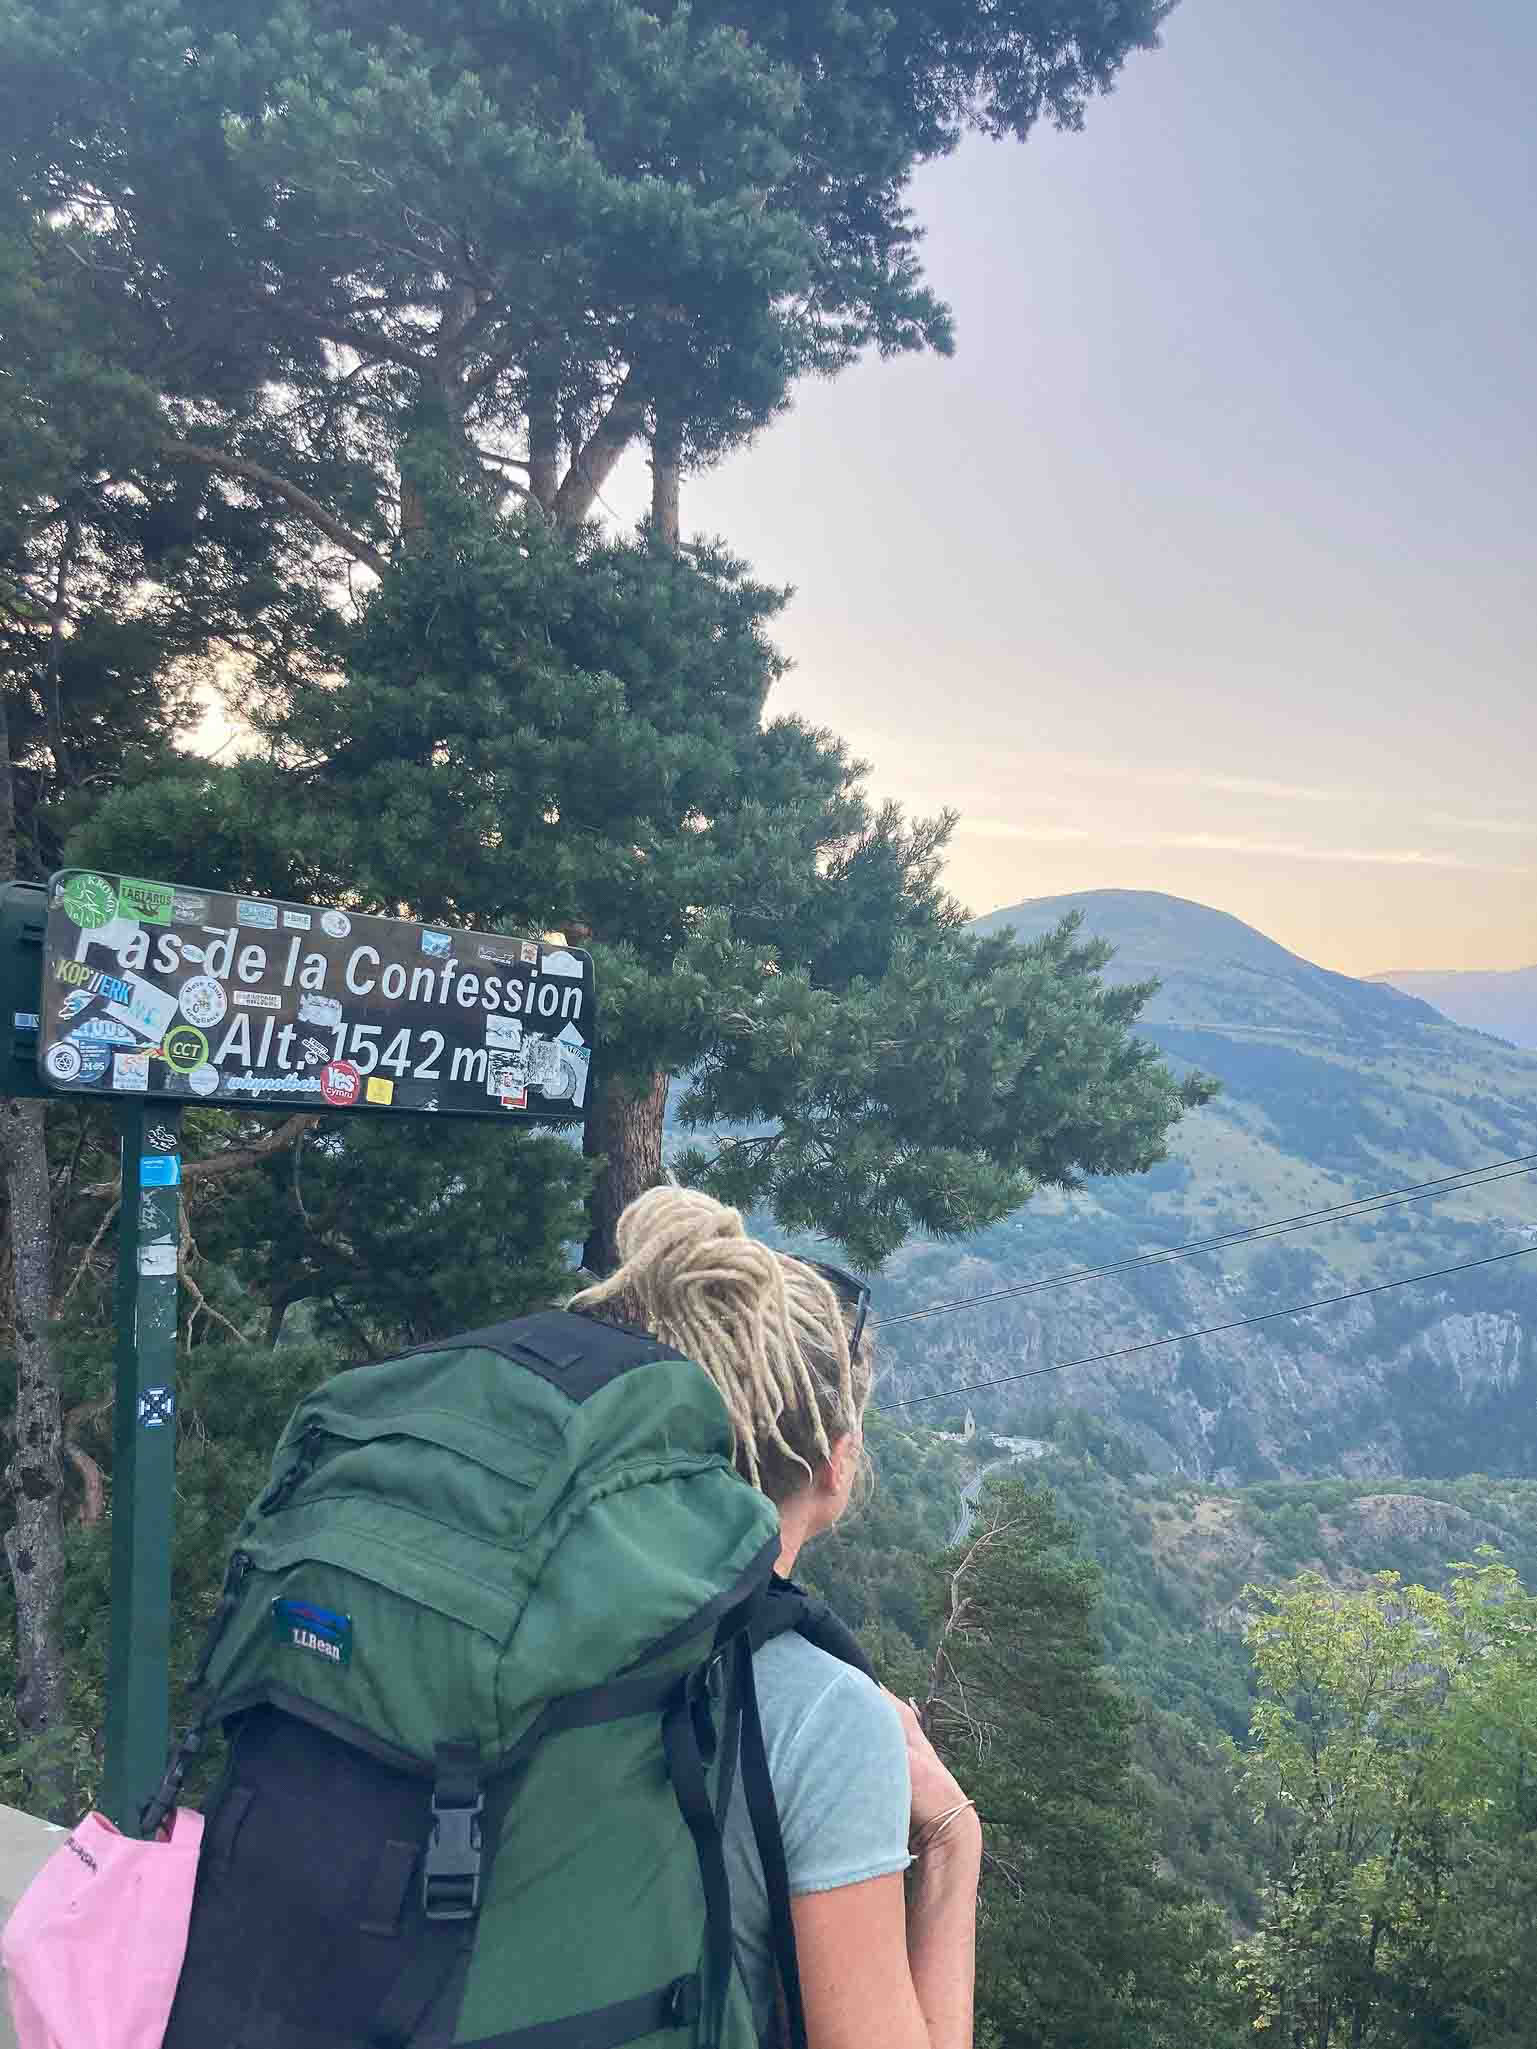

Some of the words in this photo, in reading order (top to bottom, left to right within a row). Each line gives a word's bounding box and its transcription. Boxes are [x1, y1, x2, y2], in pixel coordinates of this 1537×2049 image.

[203, 928, 267, 984] de
[283, 936, 328, 991] la
[346, 945, 583, 1019] Confession
[173, 1041, 201, 1057] CCT
[212, 1012, 305, 1070] Alt.
[330, 1022, 445, 1079] 1542
[450, 1047, 488, 1083] m
[328, 1066, 355, 1092] Yes
